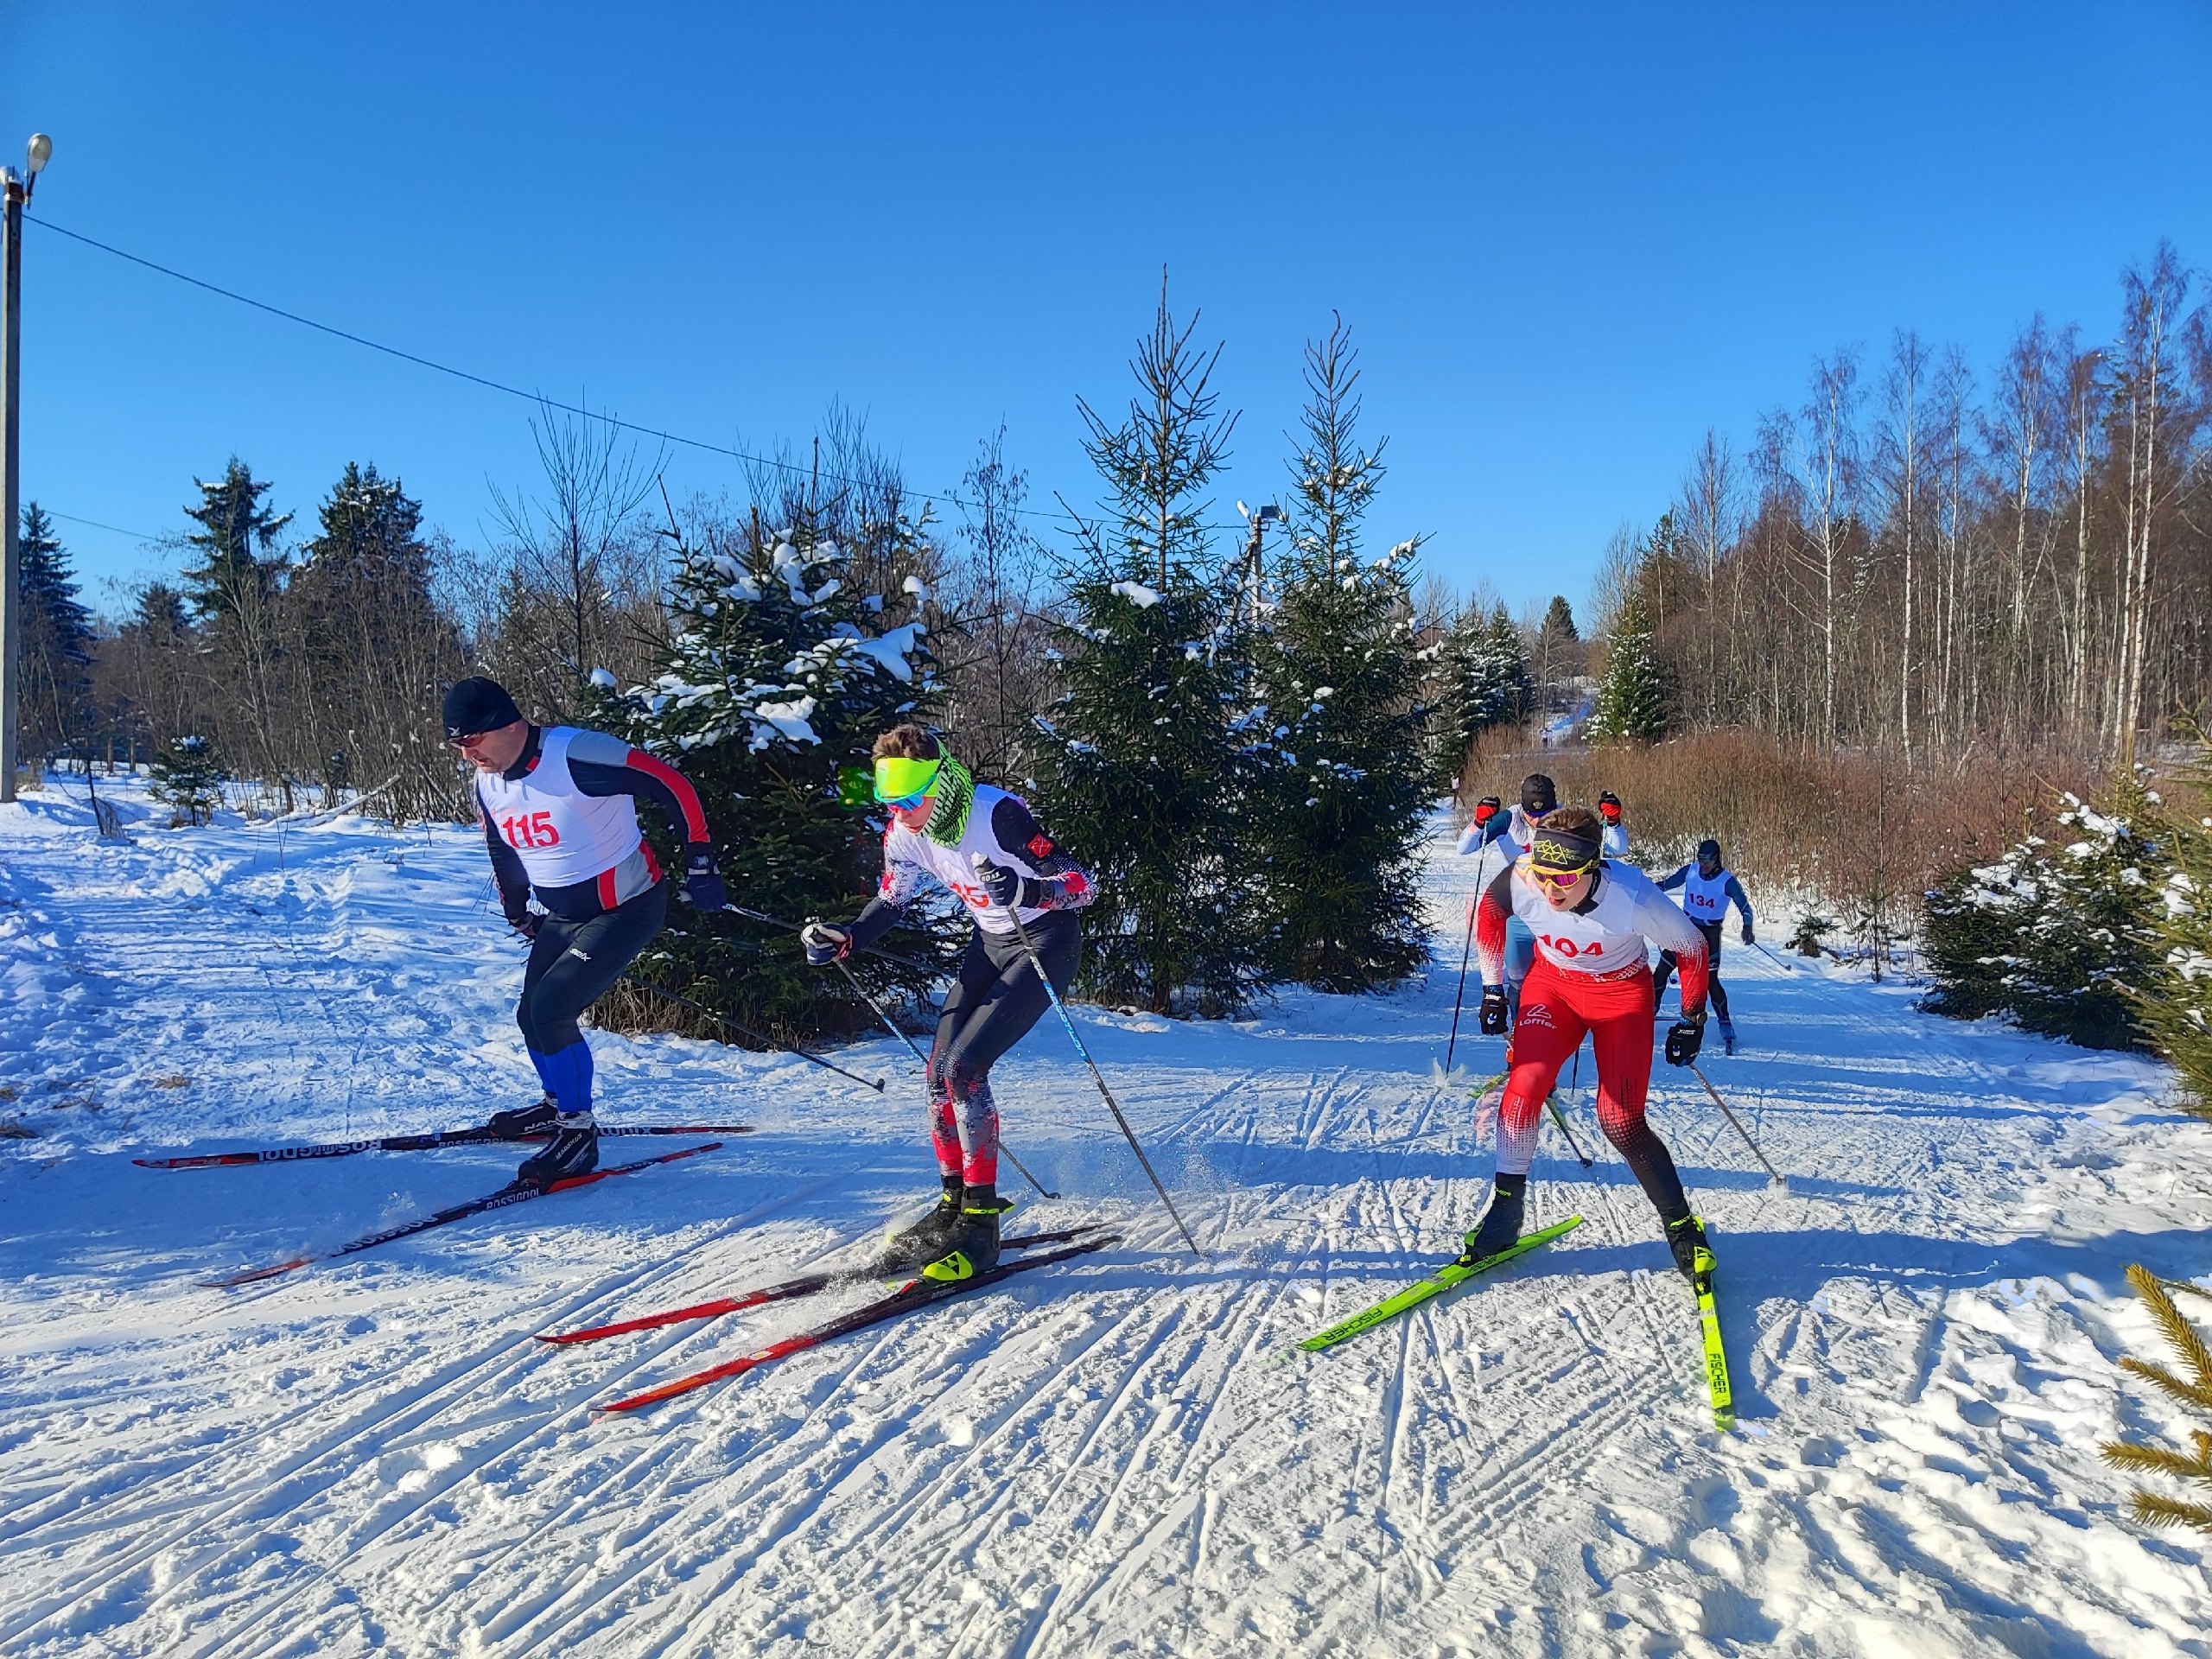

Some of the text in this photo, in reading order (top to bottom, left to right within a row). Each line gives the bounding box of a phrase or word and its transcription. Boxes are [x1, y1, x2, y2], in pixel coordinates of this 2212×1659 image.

[502, 810, 560, 849] 115
[1689, 893, 1715, 909] 134
[1538, 934, 1605, 958] 104
[555, 1132, 583, 1161] MADSHUS
[1322, 1307, 1383, 1341] FISCHER
[1708, 1353, 1727, 1395] FISCHER
